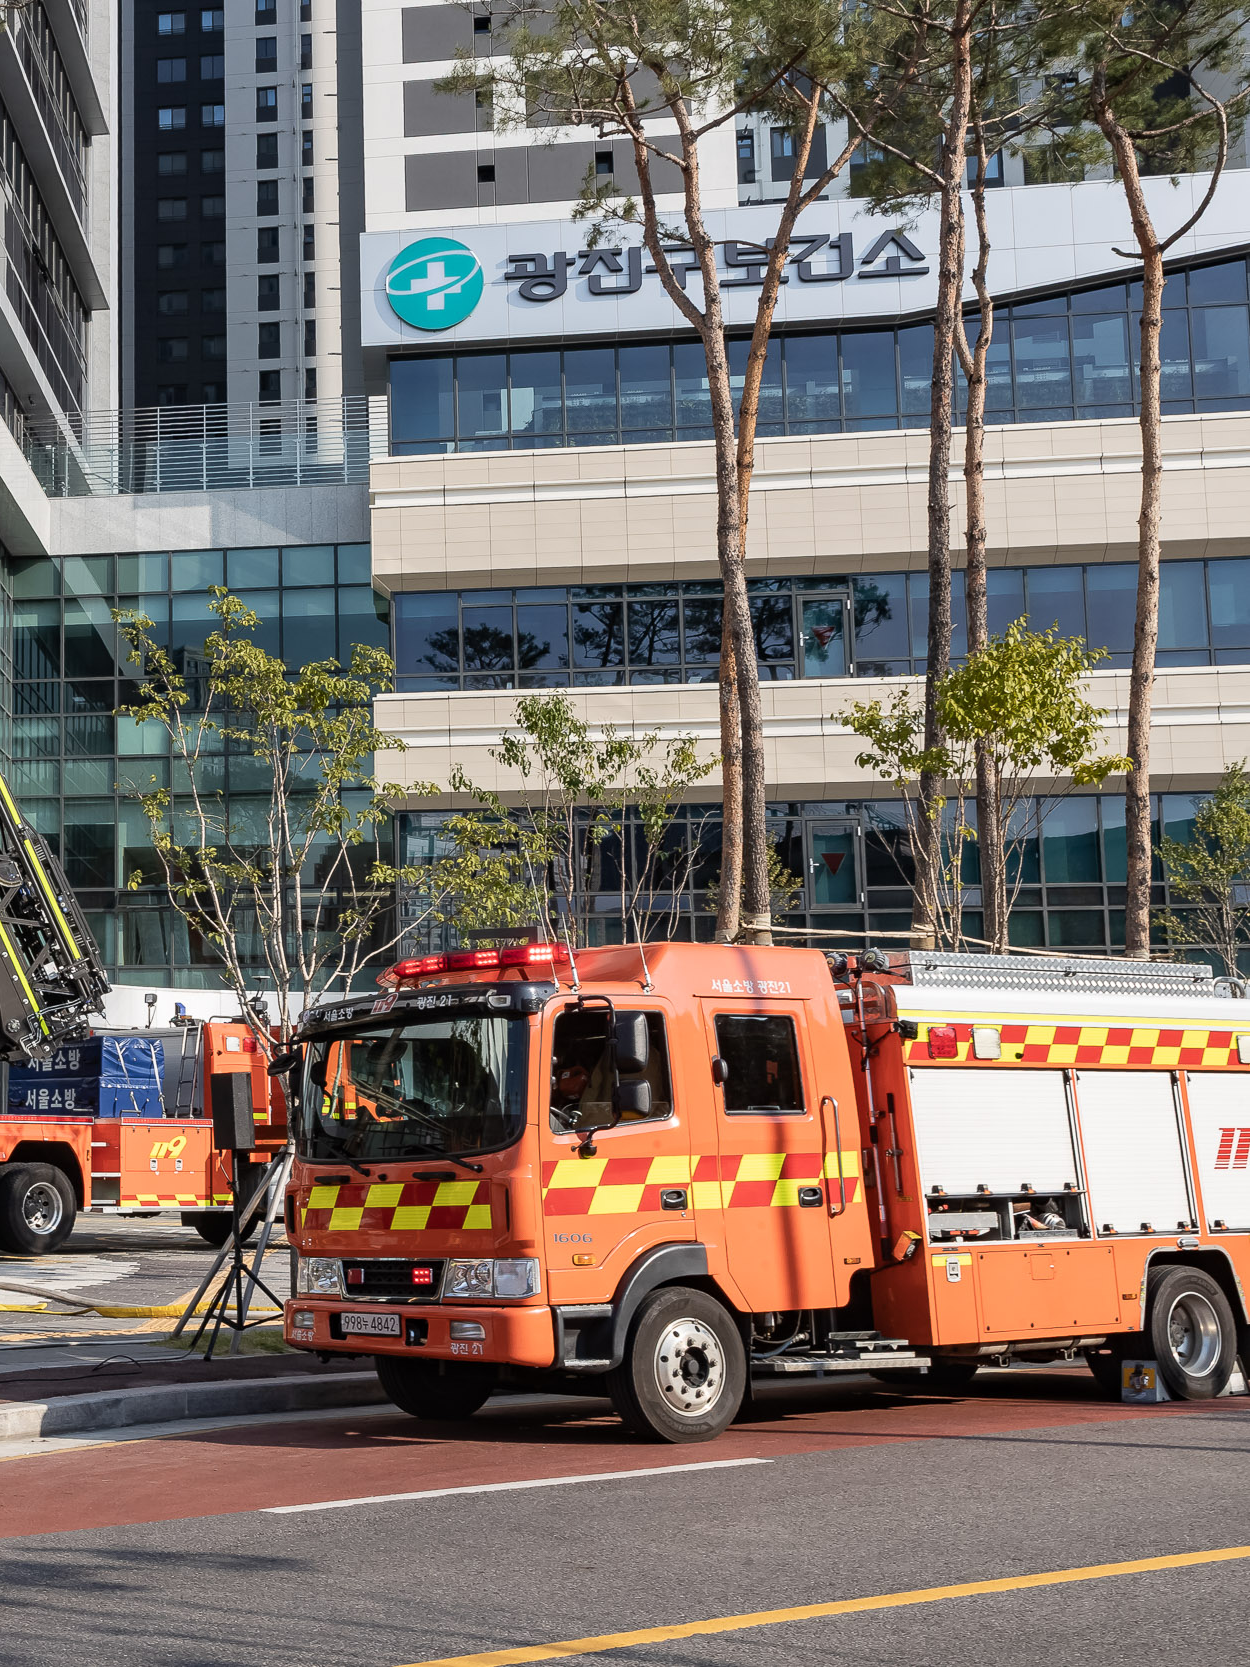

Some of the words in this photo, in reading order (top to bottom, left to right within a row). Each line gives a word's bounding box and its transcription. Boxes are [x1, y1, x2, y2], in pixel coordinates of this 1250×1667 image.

[504, 229, 930, 302] 광진구보건소
[711, 979, 754, 994] 서울소방
[757, 980, 792, 995] 광진21
[323, 1007, 354, 1023] 서울소방
[416, 996, 437, 1010] 광진
[439, 994, 452, 1006] 21
[27, 1049, 81, 1072] 서울소방
[25, 1088, 77, 1110] 서울소방
[150, 1135, 187, 1159] 119
[553, 1233, 593, 1243] 1606
[450, 1343, 469, 1355] 광진
[471, 1343, 484, 1355] 21
